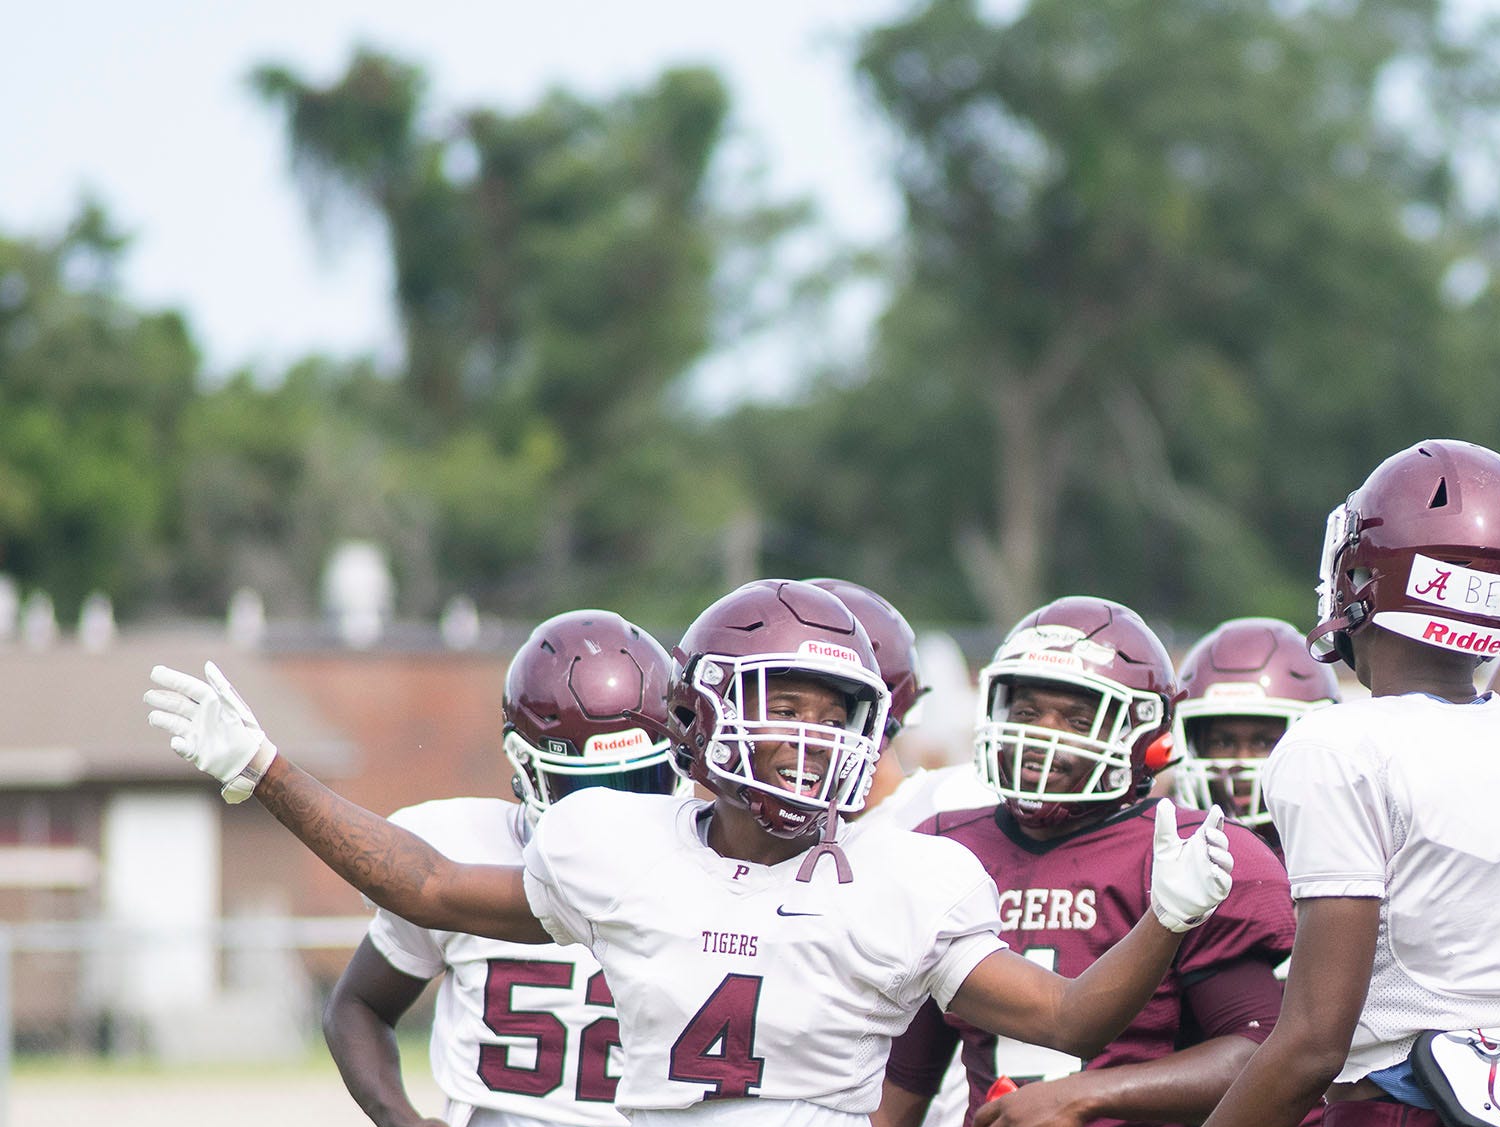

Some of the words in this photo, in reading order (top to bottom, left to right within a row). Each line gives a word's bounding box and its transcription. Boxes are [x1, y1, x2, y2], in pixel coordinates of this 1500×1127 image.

[1415, 567, 1452, 601] A
[808, 643, 856, 663] Riddell
[1027, 651, 1075, 665] Riddell
[593, 734, 643, 751] Riddell
[779, 808, 806, 823] Riddell
[732, 864, 750, 880] P
[701, 930, 759, 957] TIGERS
[668, 972, 766, 1102] 4
